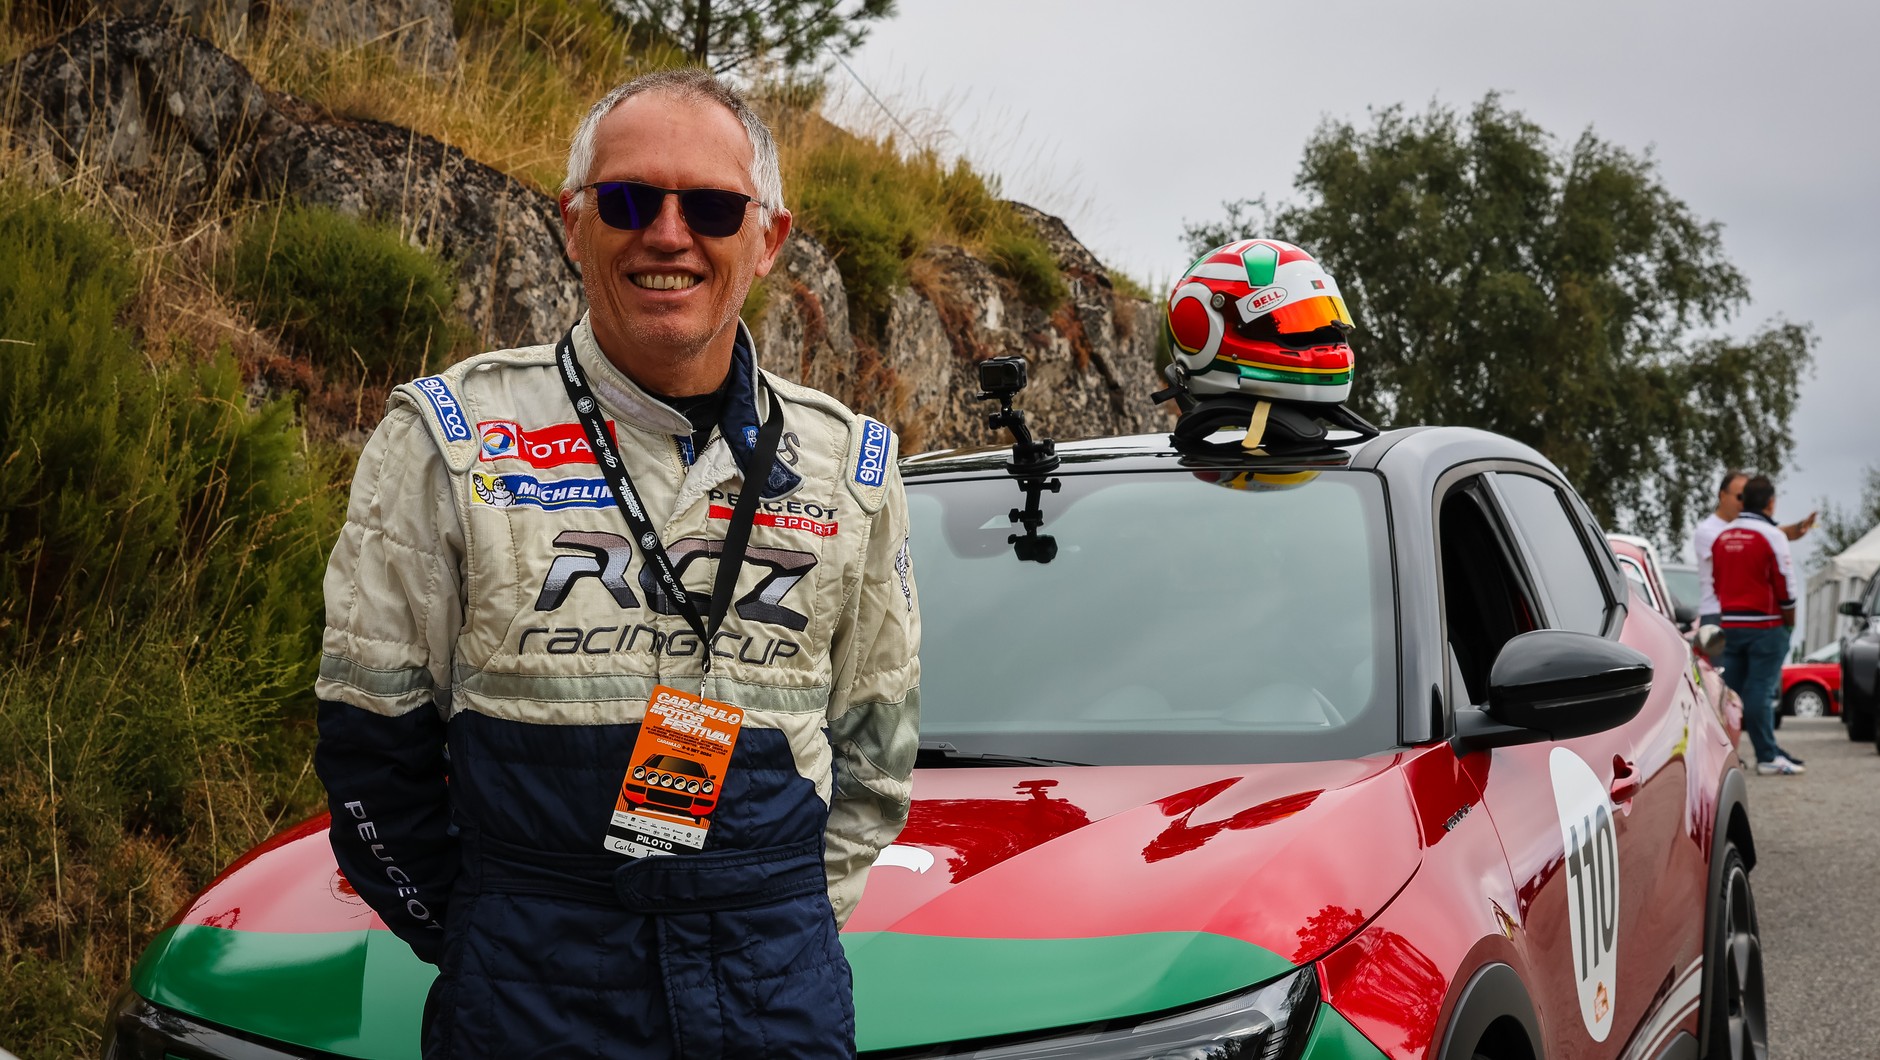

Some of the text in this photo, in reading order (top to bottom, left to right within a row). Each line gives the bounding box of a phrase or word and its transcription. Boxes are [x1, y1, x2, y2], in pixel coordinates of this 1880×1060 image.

[1252, 291, 1281, 309] BELL
[422, 379, 467, 438] sparco
[519, 434, 592, 459] TOTA
[603, 446, 619, 469] Alfa
[860, 422, 883, 482] sparco
[709, 489, 838, 520] PEGEOT
[774, 517, 835, 534] SPORT
[534, 530, 818, 632] RCZ
[671, 581, 687, 604] Alfa
[710, 632, 800, 665] CUP
[649, 702, 705, 727] MOTOR
[656, 692, 741, 725] CARAMULO
[661, 716, 733, 746] FESTIVAL
[614, 840, 636, 854] Carlos
[636, 834, 672, 851] PILOTO
[1568, 804, 1619, 982] 110
